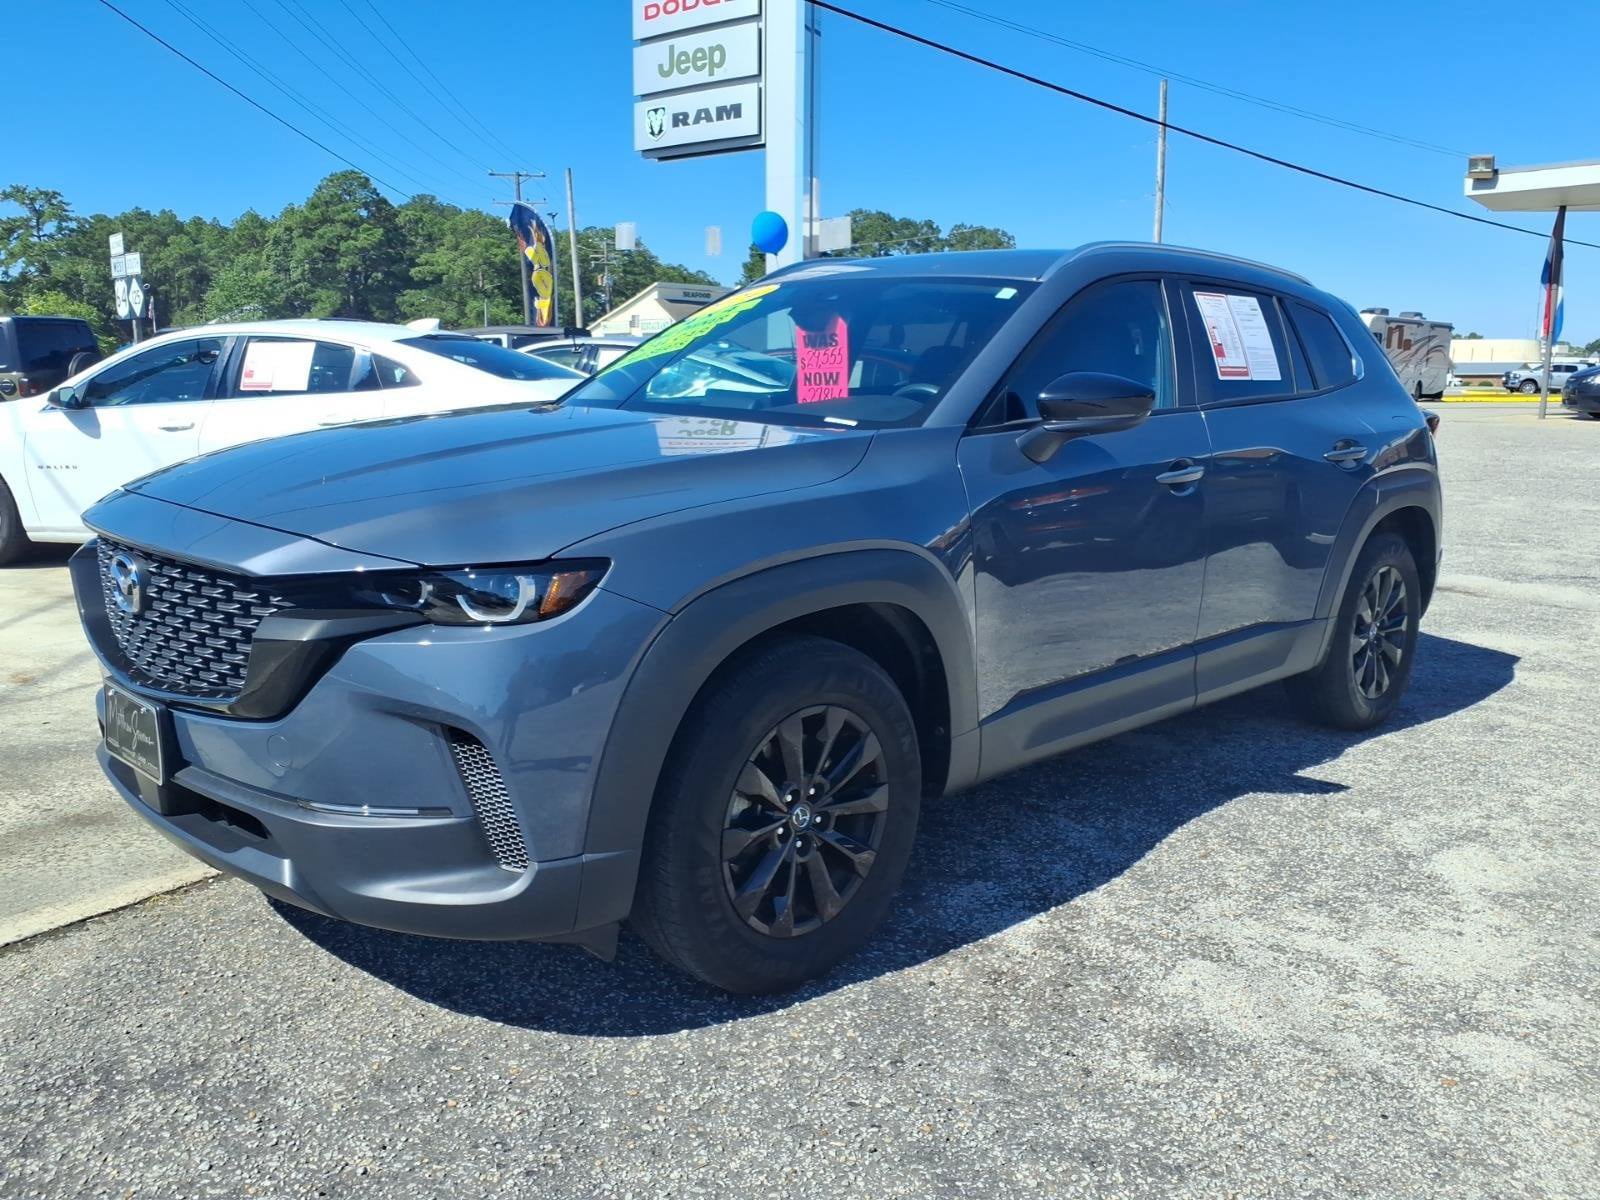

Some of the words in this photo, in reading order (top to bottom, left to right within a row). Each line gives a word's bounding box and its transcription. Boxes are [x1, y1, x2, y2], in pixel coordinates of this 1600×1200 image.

[644, 0, 736, 20] DOD
[657, 43, 726, 78] Jeep
[671, 103, 742, 128] RAM
[682, 291, 711, 299] SEAFOOD
[802, 332, 839, 348] WAS
[803, 371, 841, 387] NOW
